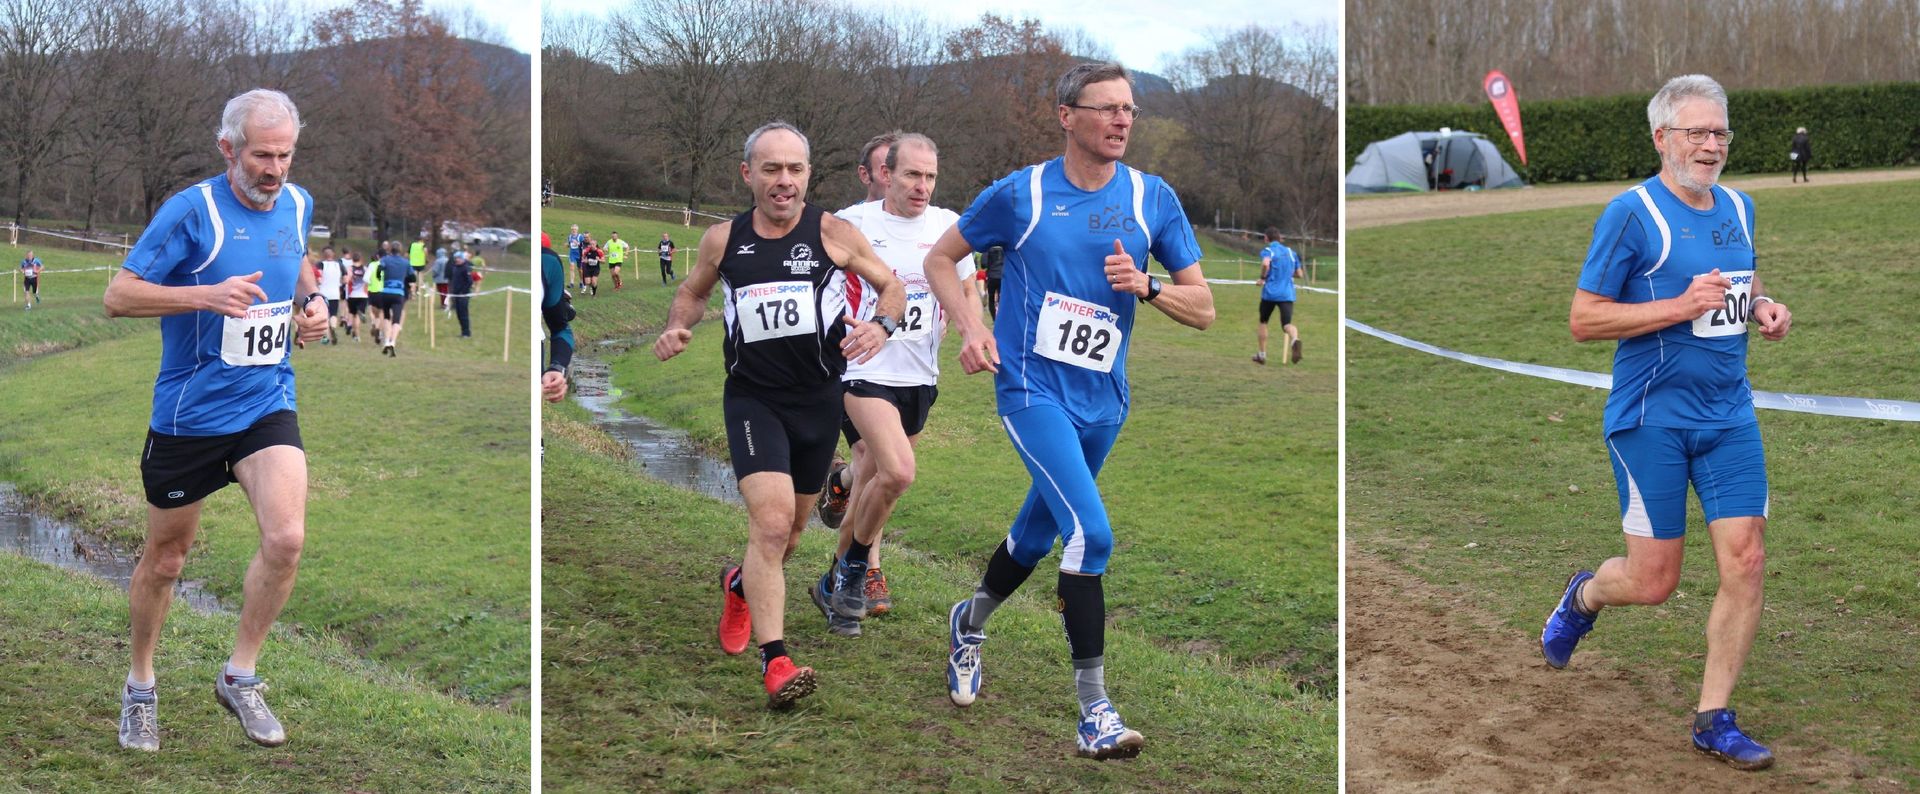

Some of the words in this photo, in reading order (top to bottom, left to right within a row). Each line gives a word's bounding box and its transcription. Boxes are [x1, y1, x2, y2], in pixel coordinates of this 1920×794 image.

[1088, 213, 1136, 232] BAC
[748, 285, 809, 298] INTERSPORT
[906, 292, 928, 301] PORT
[755, 298, 800, 331] 178
[1710, 292, 1747, 327] 200
[243, 322, 286, 357] 184
[1058, 319, 1111, 362] 182
